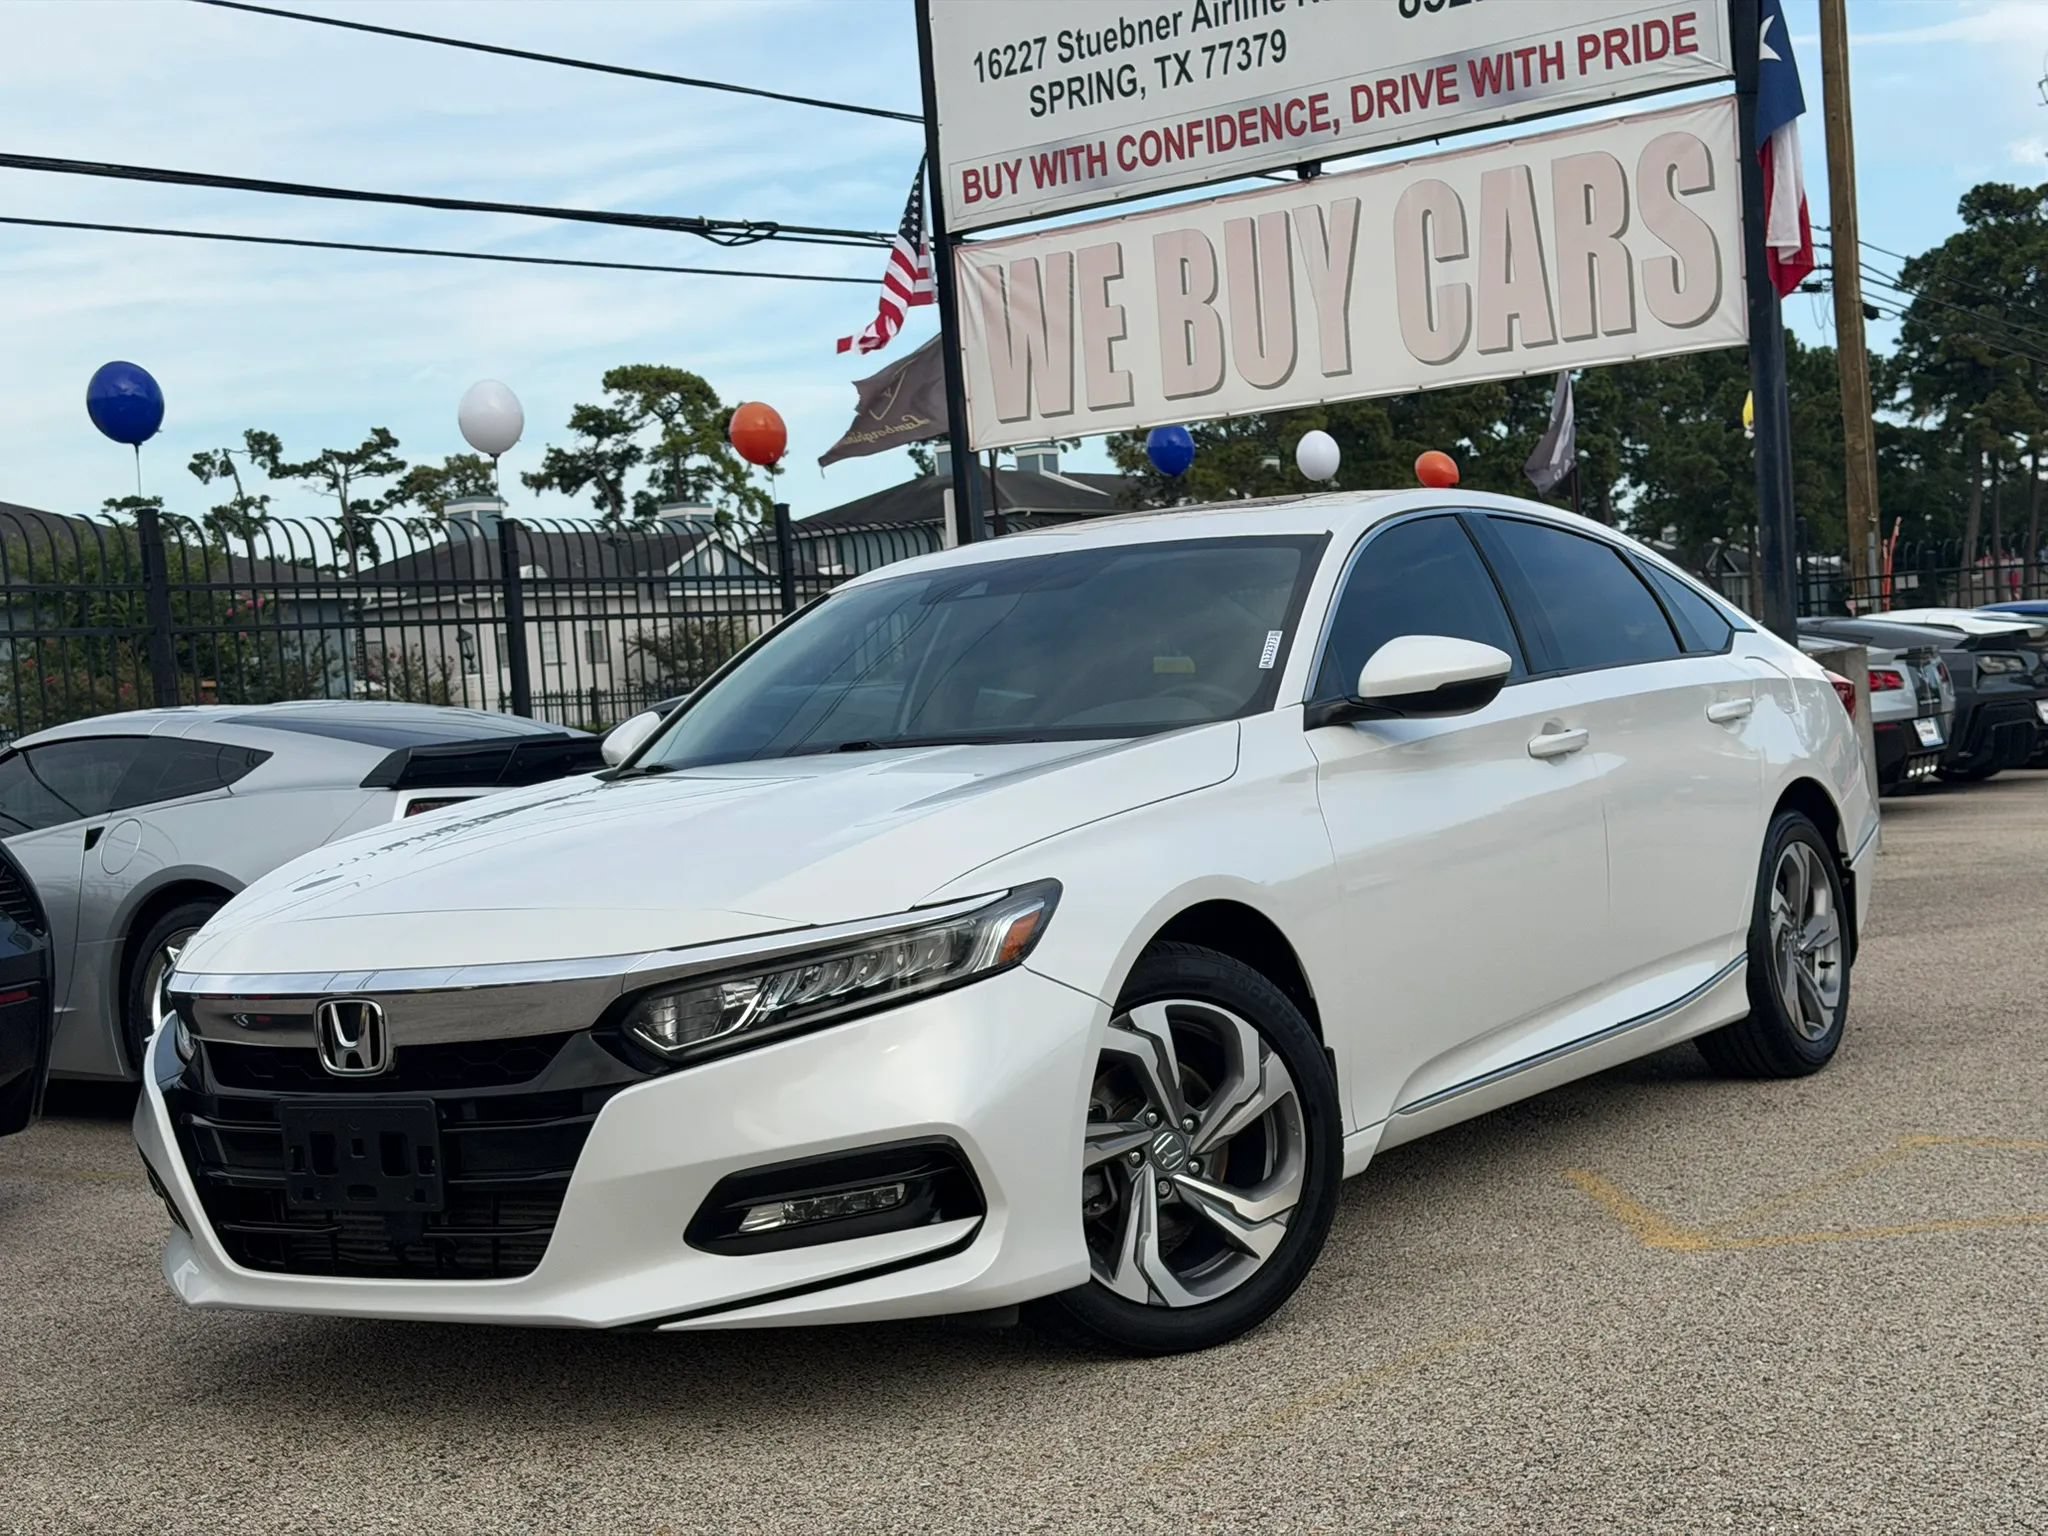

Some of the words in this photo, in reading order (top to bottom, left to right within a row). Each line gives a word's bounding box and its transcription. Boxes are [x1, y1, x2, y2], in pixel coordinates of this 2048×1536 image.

[962, 158, 1022, 204] BUY
[1030, 141, 1108, 189] WITH
[1117, 92, 1341, 172] CONFIDENCE,
[1351, 64, 1459, 124] DRIVE
[1468, 41, 1566, 99] WITH
[1577, 12, 1699, 75] PRIDE
[974, 36, 1047, 83] 16227
[1057, 10, 1184, 64] Stuebner
[1029, 64, 1147, 117] SPRING,
[1154, 50, 1194, 89] TX
[1201, 28, 1288, 80] 77379
[978, 242, 1135, 424] WE
[1153, 198, 1361, 401] BUY
[1394, 132, 1723, 366] CARS
